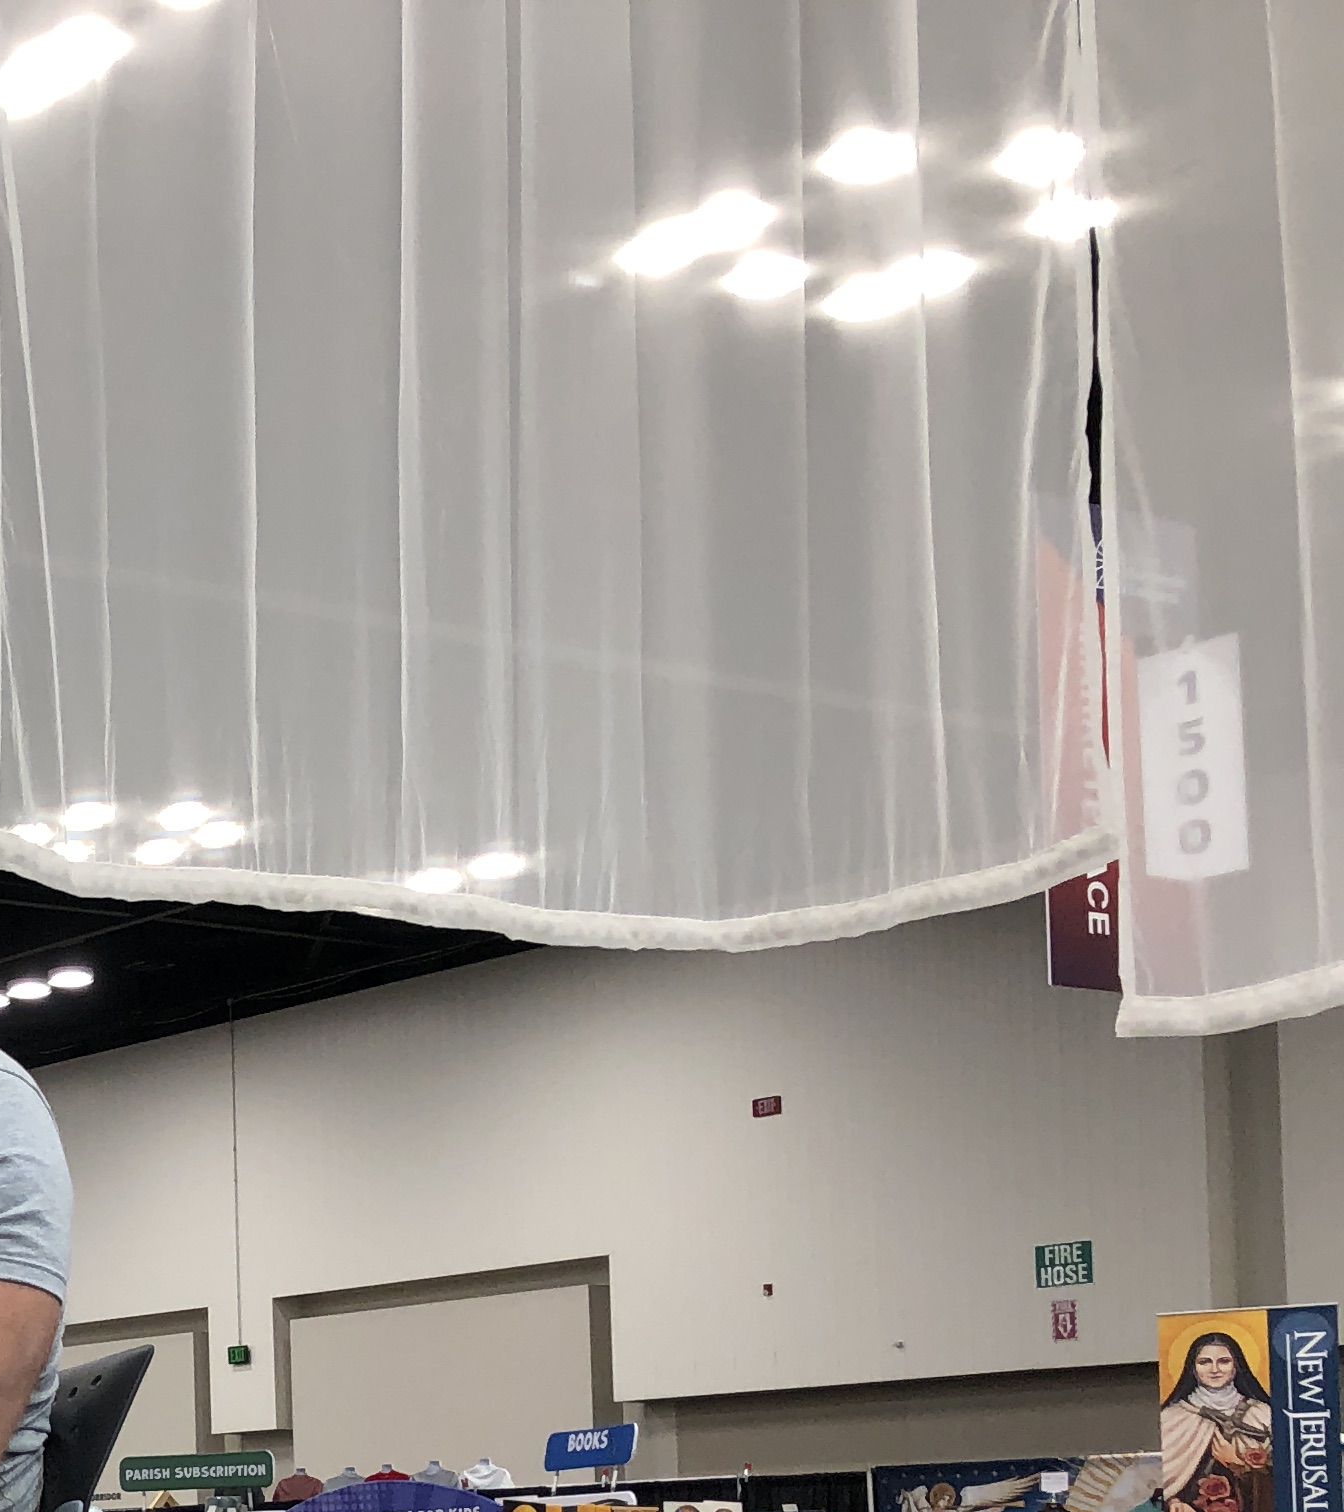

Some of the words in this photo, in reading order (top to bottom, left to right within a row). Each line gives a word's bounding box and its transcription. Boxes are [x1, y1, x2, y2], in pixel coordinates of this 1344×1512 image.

[1044, 1243, 1083, 1266] FIRE
[1040, 1263, 1088, 1287] HOSE
[229, 1347, 245, 1363] EXIT
[1293, 1330, 1329, 1407] NEW
[567, 1429, 609, 1453] BOOKS
[125, 1467, 171, 1481] PARISH
[174, 1463, 267, 1479] SUBSCRIPTION
